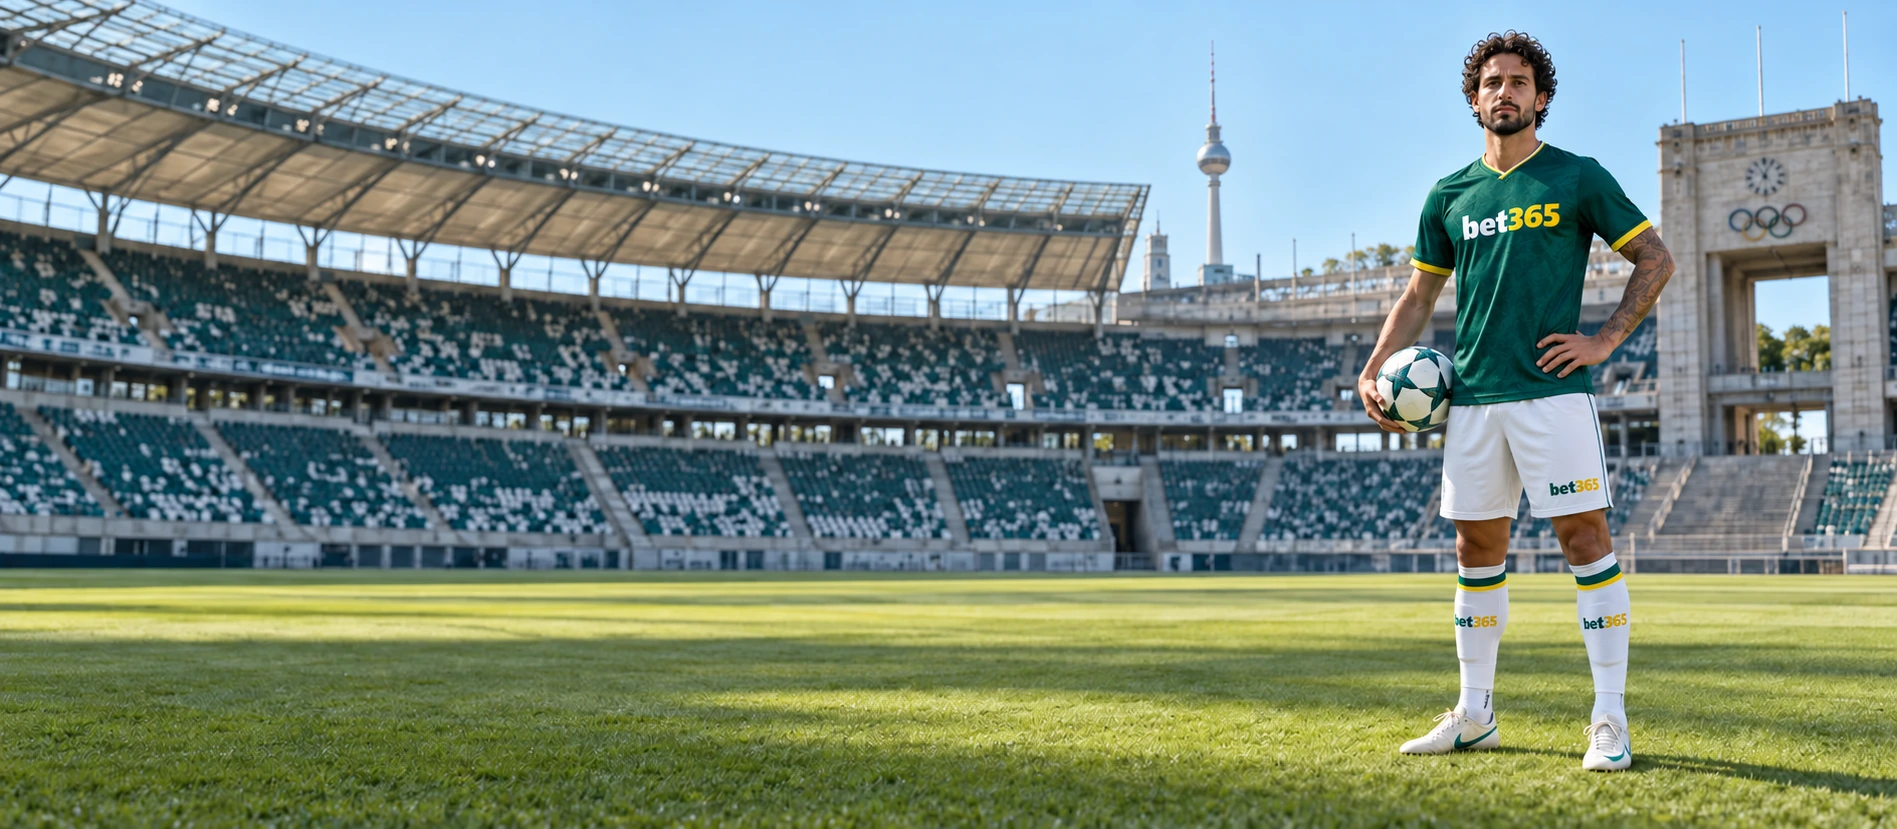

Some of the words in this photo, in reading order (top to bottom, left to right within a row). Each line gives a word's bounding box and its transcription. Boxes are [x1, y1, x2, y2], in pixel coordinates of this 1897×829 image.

[1462, 203, 1560, 241] bet365
[1549, 478, 1599, 496] bet365
[1583, 613, 1627, 629] bet365
